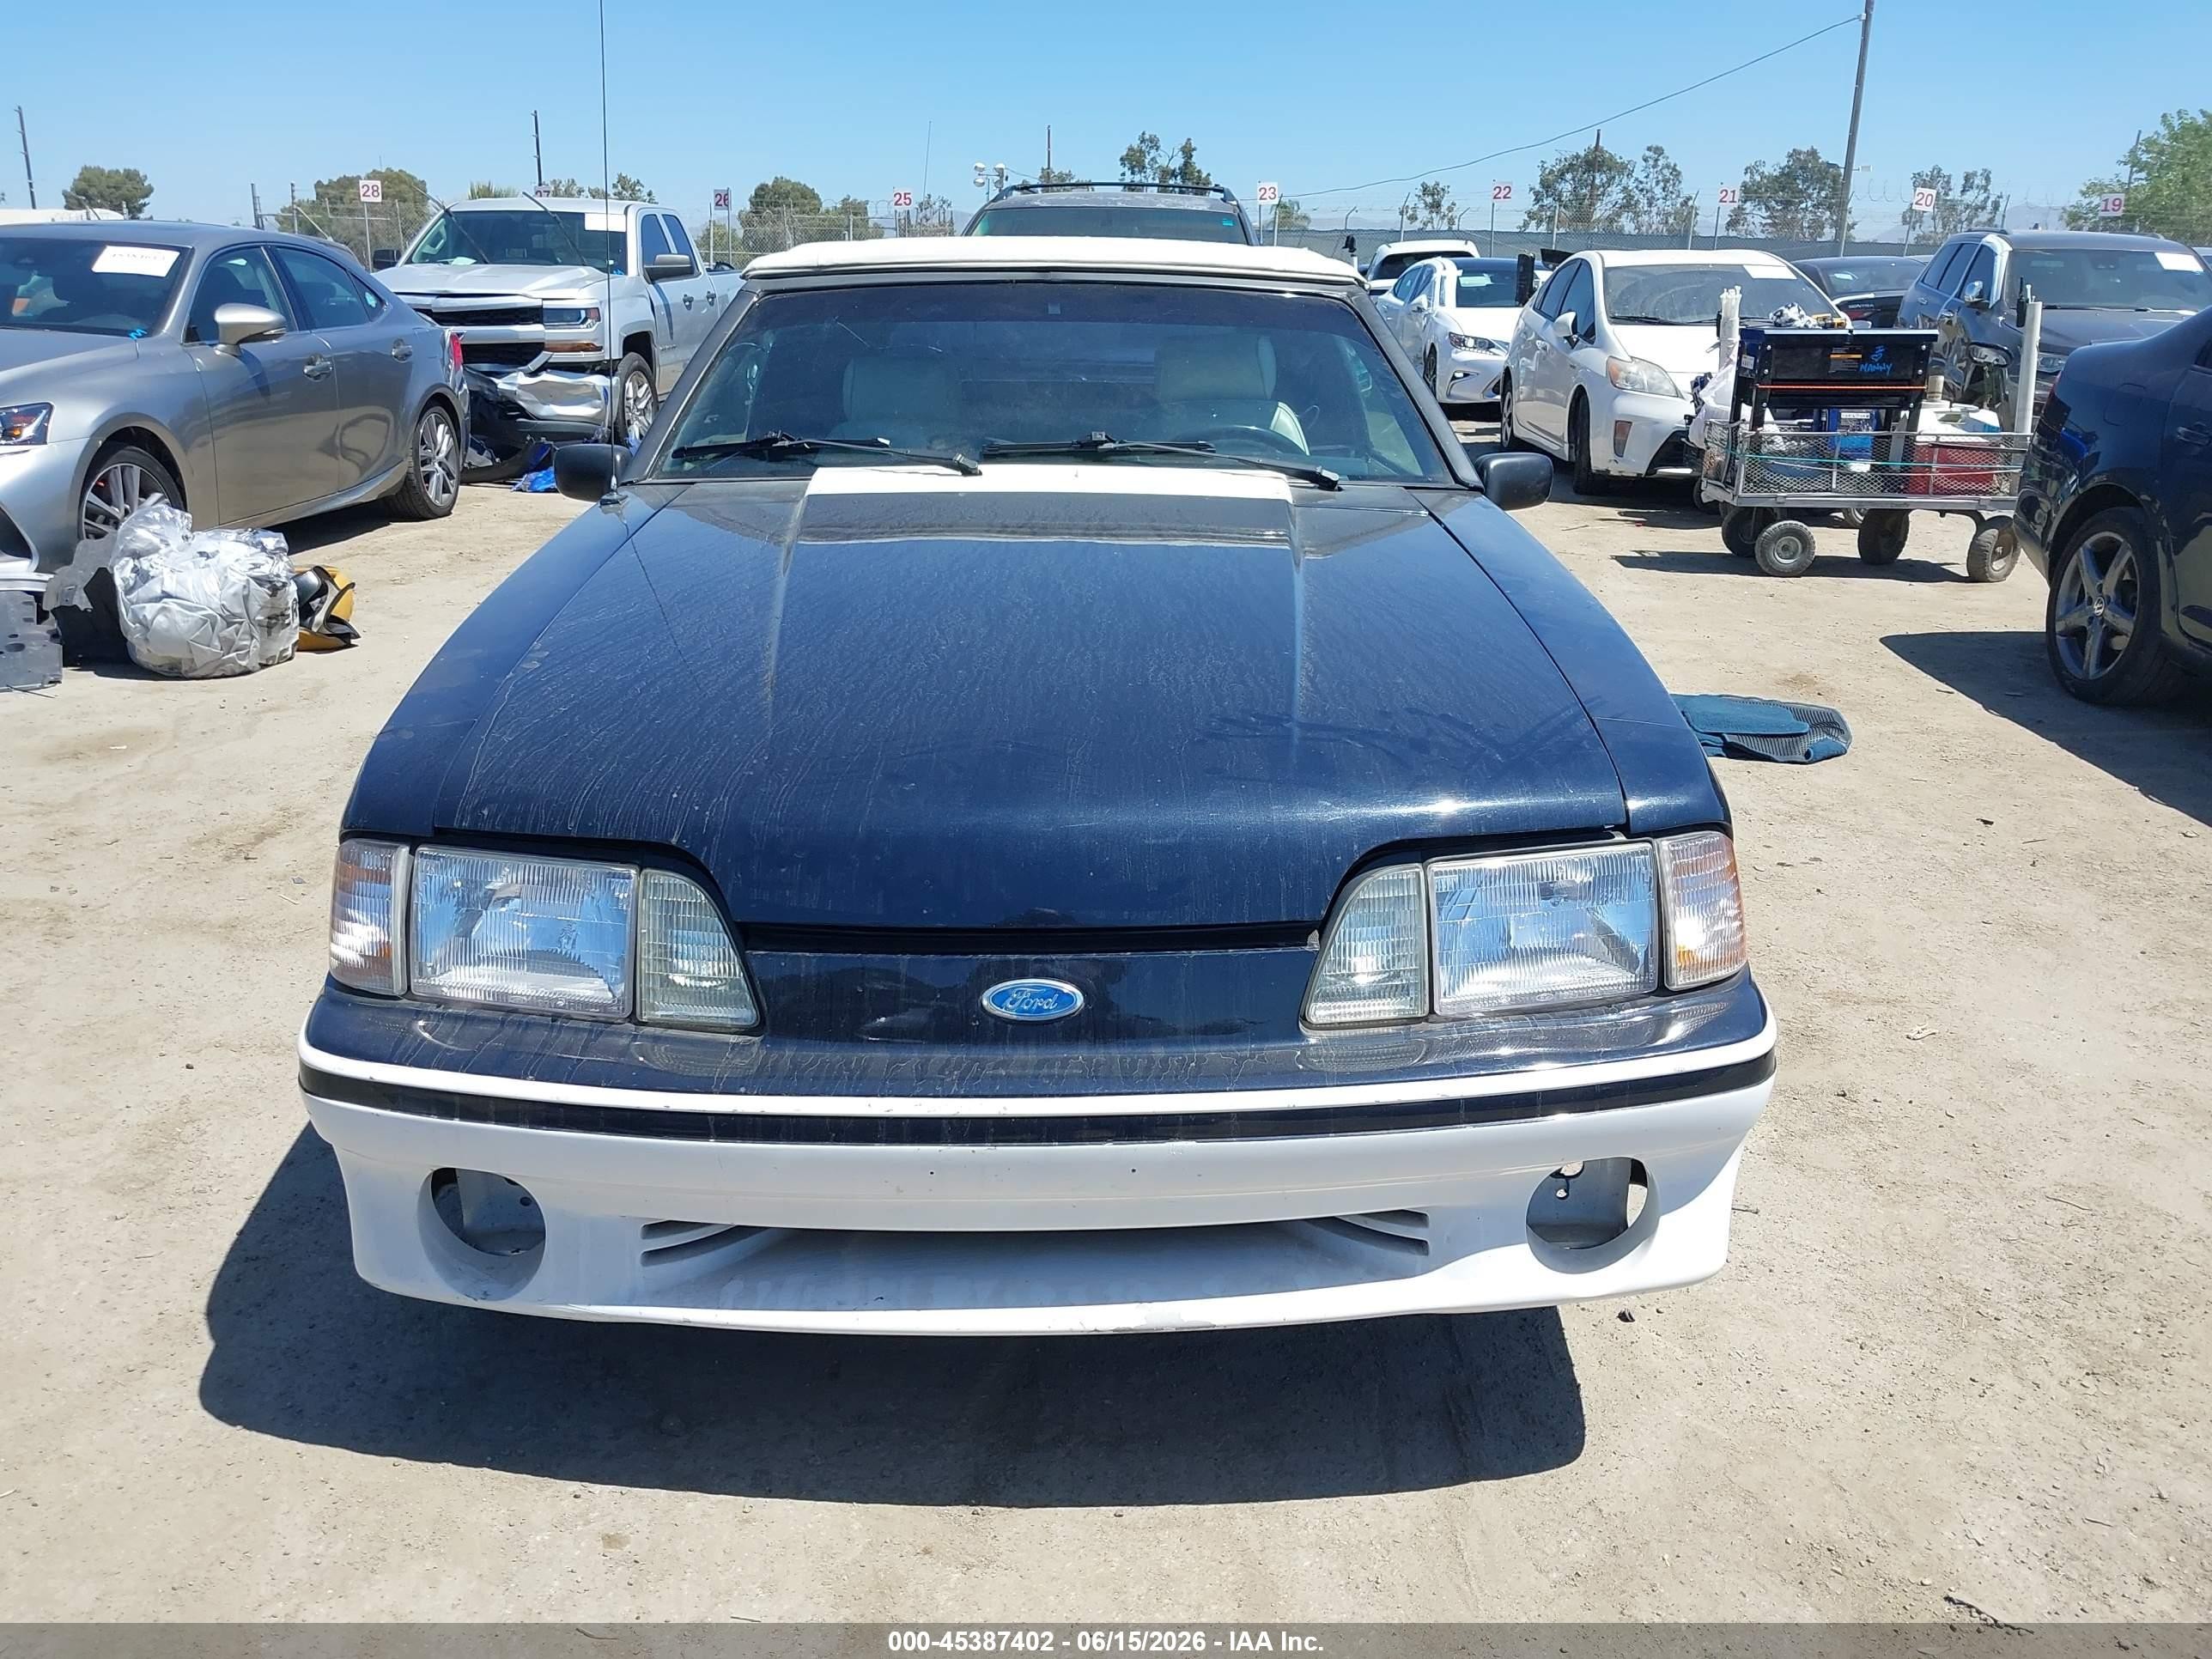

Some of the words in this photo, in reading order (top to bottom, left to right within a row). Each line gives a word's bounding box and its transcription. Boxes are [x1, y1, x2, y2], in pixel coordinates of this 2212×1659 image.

[361, 184, 380, 198] 28
[893, 191, 913, 207] 25
[1258, 185, 1278, 201] 23
[1492, 185, 1512, 200] 22
[1717, 188, 1738, 204] 21
[1914, 191, 1934, 208] 20
[2100, 198, 2123, 212] 19
[1002, 987, 1060, 1012] Ford
